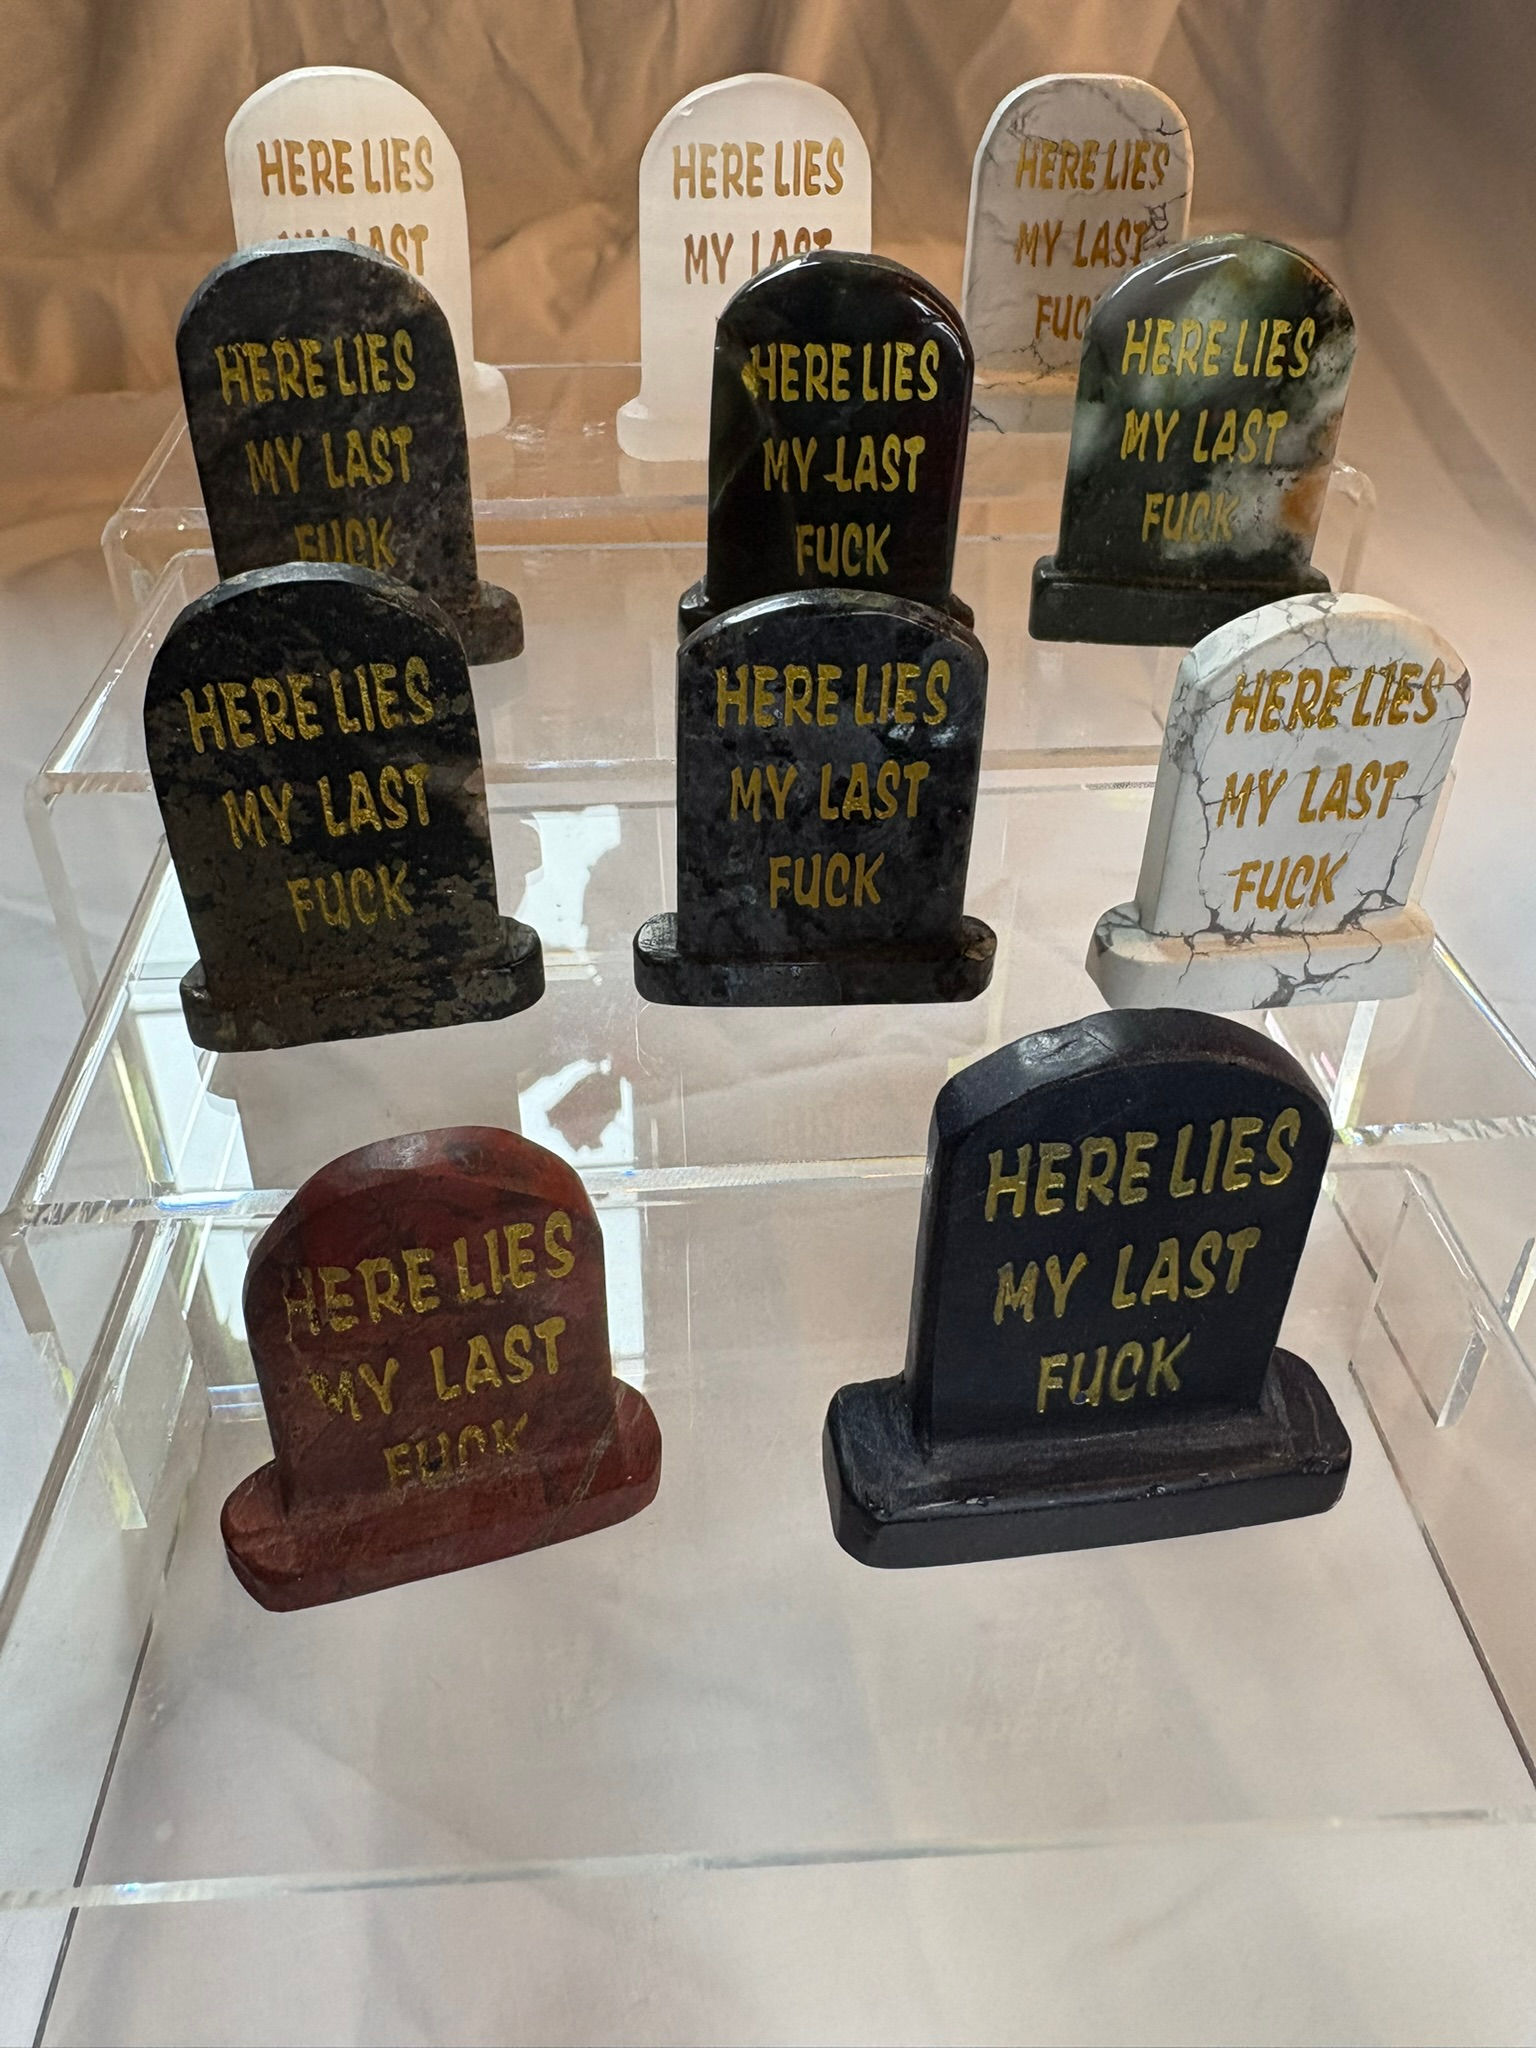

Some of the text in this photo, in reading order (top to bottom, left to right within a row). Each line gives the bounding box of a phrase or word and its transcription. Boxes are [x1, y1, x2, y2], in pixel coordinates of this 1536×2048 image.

[257, 135, 434, 196] HERE LIES
[672, 136, 845, 200] HERE LIES
[1015, 138, 1170, 191] HERE LIES
[684, 232, 734, 285] MY
[1014, 216, 1152, 269] MY LAST
[1035, 294, 1100, 341] FUC
[1121, 317, 1316, 378] HERE LIES
[214, 329, 416, 405] HERE LIES
[741, 339, 940, 402] HERE LIES
[245, 425, 413, 495] MY LAST
[763, 433, 926, 493] MY LAST
[1120, 408, 1288, 465] MY LAST
[295, 515, 396, 571] FUCK
[1142, 491, 1241, 543] FUCK
[795, 522, 891, 577] FUCK
[180, 656, 435, 754] HERE LIES
[716, 659, 951, 728] HERE LIES
[1225, 657, 1446, 735] HERE LIES
[222, 763, 431, 850] MY LAST
[730, 759, 930, 823] MY LAST
[1216, 759, 1409, 829] MY LAST
[286, 861, 414, 933] FUCK
[769, 851, 885, 909] FUCK
[1227, 851, 1350, 913] FUCK
[984, 1107, 1300, 1223] HERE LIES
[283, 1209, 576, 1343] HERE LIES
[993, 1226, 1261, 1326] MY LAST
[306, 1316, 566, 1422] MY LAST
[1037, 1332, 1192, 1413] FUCK
